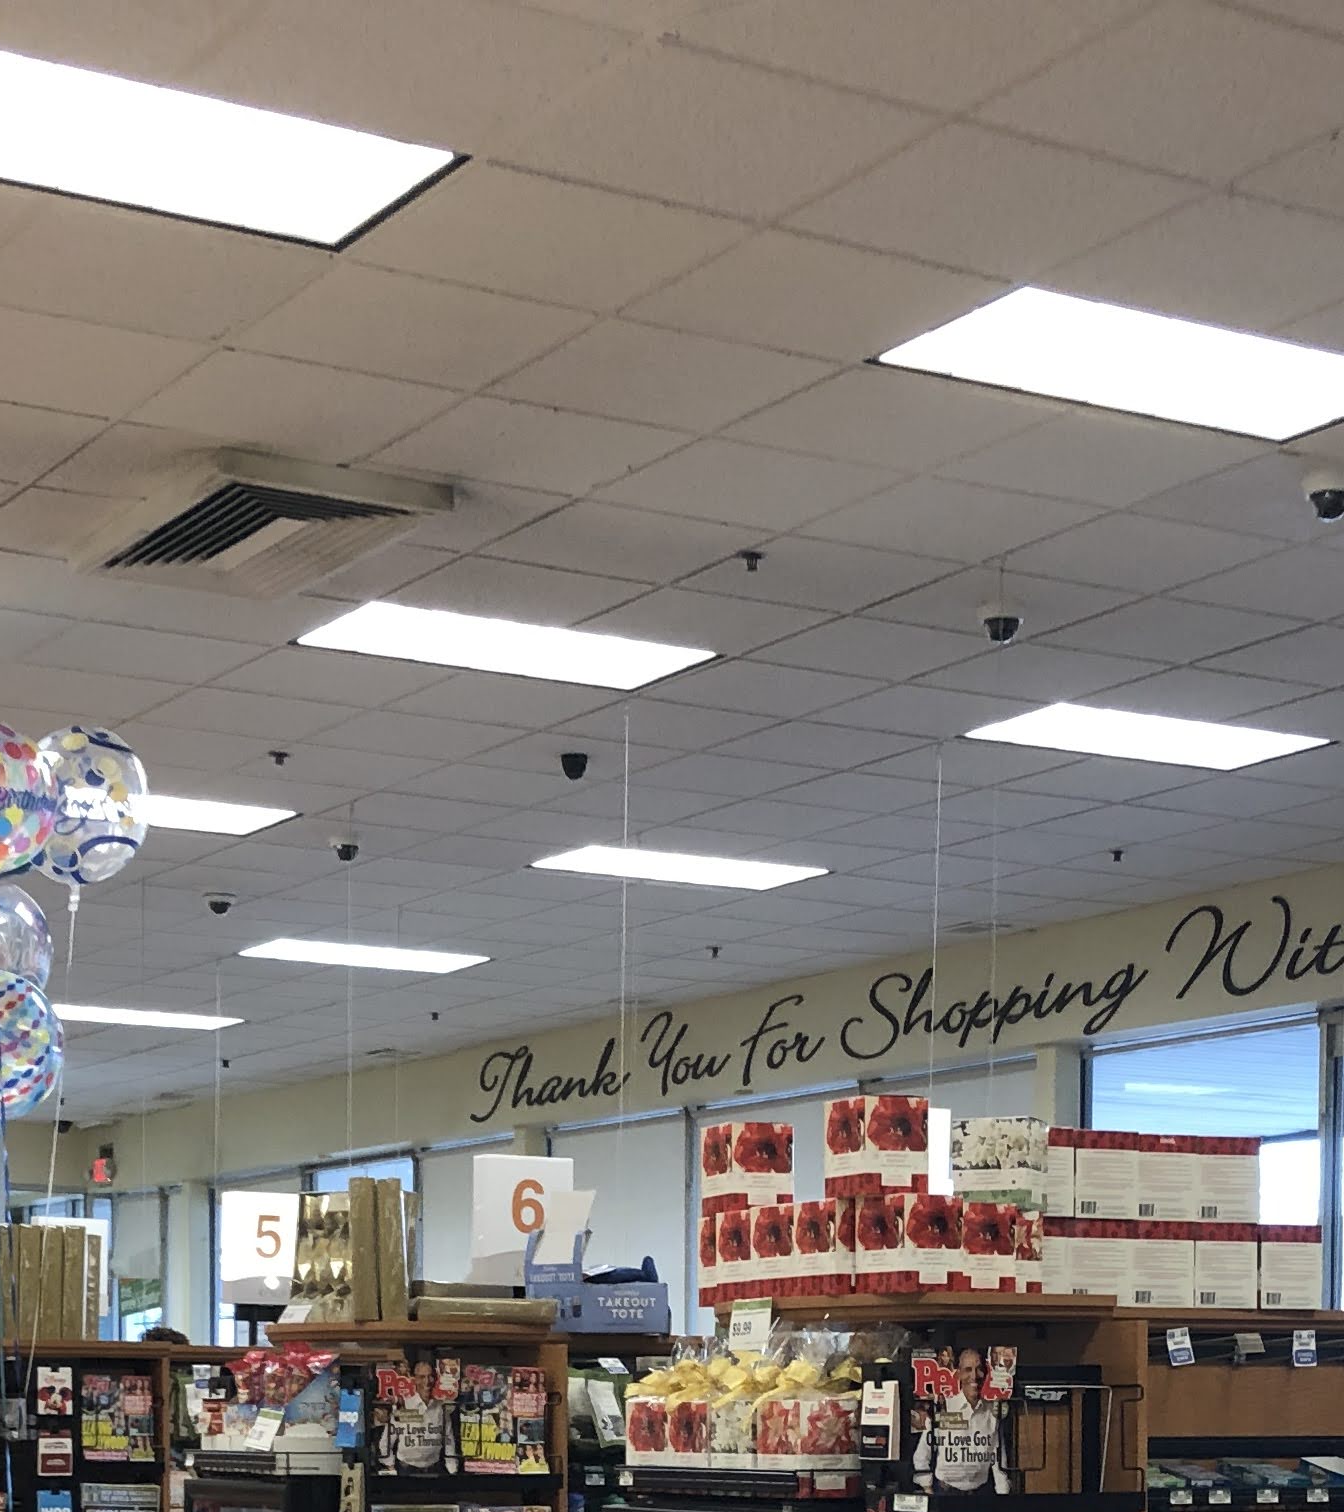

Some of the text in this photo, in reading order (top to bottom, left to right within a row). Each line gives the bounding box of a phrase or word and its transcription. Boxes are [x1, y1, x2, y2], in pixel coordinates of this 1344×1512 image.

[469, 1045, 631, 1122] Thank
[641, 1011, 731, 1096] You
[740, 994, 826, 1086] For
[840, 966, 1149, 1060] Shopping
[511, 1178, 546, 1235] 6
[255, 1214, 282, 1259] 5
[597, 1296, 657, 1308] TAKEOUT
[611, 1308, 644, 1319] TOTE
[1024, 1388, 1068, 1401] Star
[926, 1431, 992, 1447] Our Love Got
[944, 1447, 1000, 1466] Us Throug
